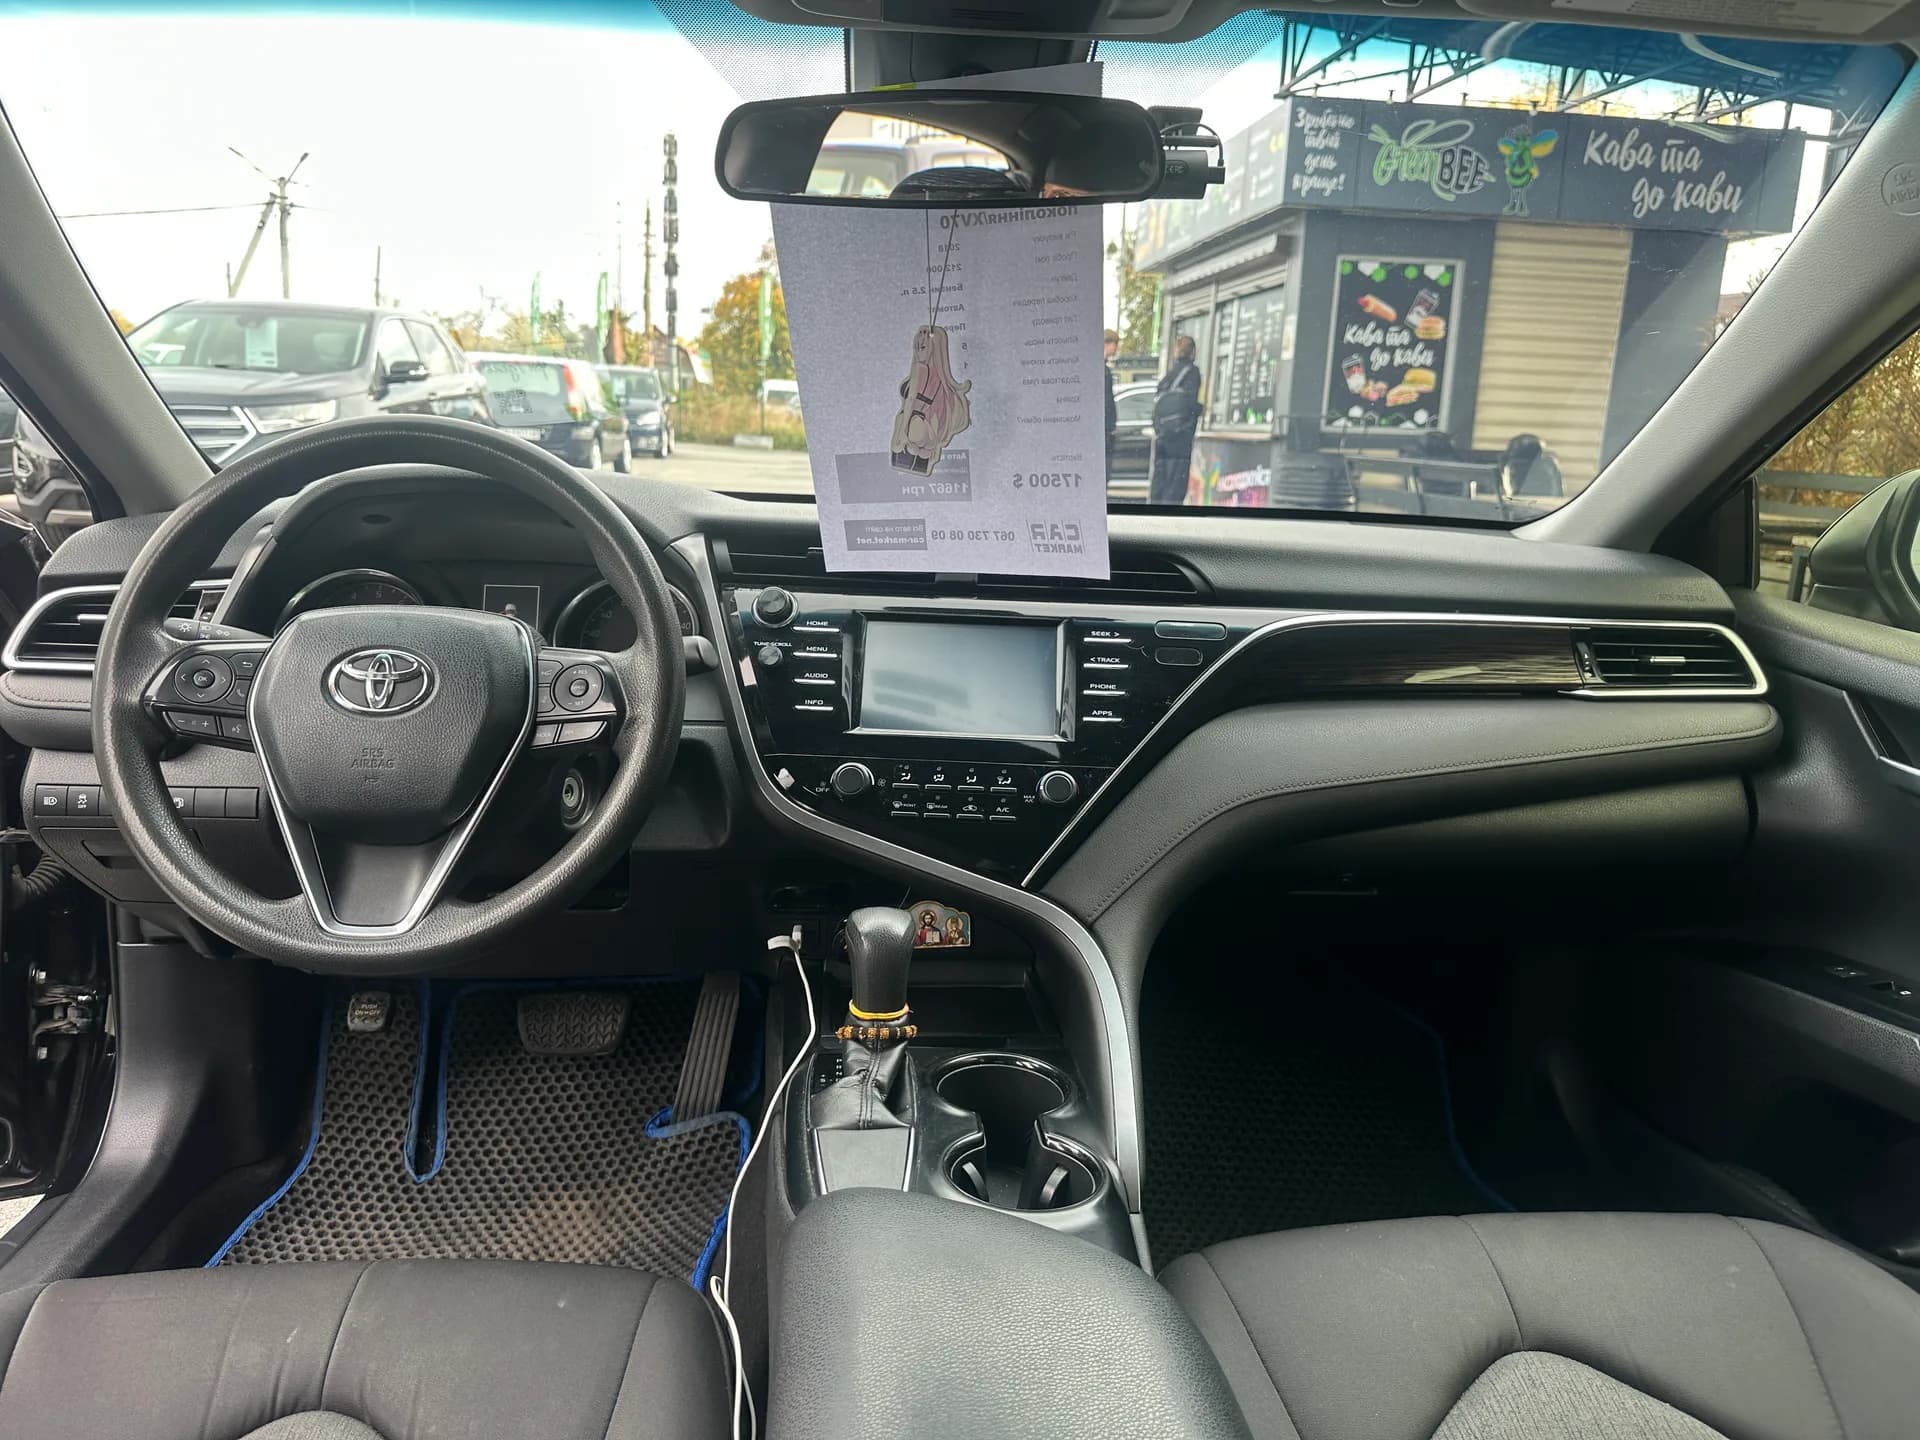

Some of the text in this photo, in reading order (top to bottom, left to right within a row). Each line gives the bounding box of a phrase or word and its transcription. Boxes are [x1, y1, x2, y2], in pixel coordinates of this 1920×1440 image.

[1585, 127, 1703, 172] Кава та
[1633, 169, 1743, 218] до кави
[1343, 320, 1411, 347] Кава та
[1369, 342, 1435, 371] до кави
[1090, 630, 1112, 638] SEEK
[1097, 656, 1121, 664] TRACK
[803, 672, 829, 680] AUDIO
[1089, 682, 1118, 690] PHONE
[1091, 709, 1114, 717] APPS
[350, 758, 396, 770] AIRBAG
[995, 806, 1011, 814] A/C
